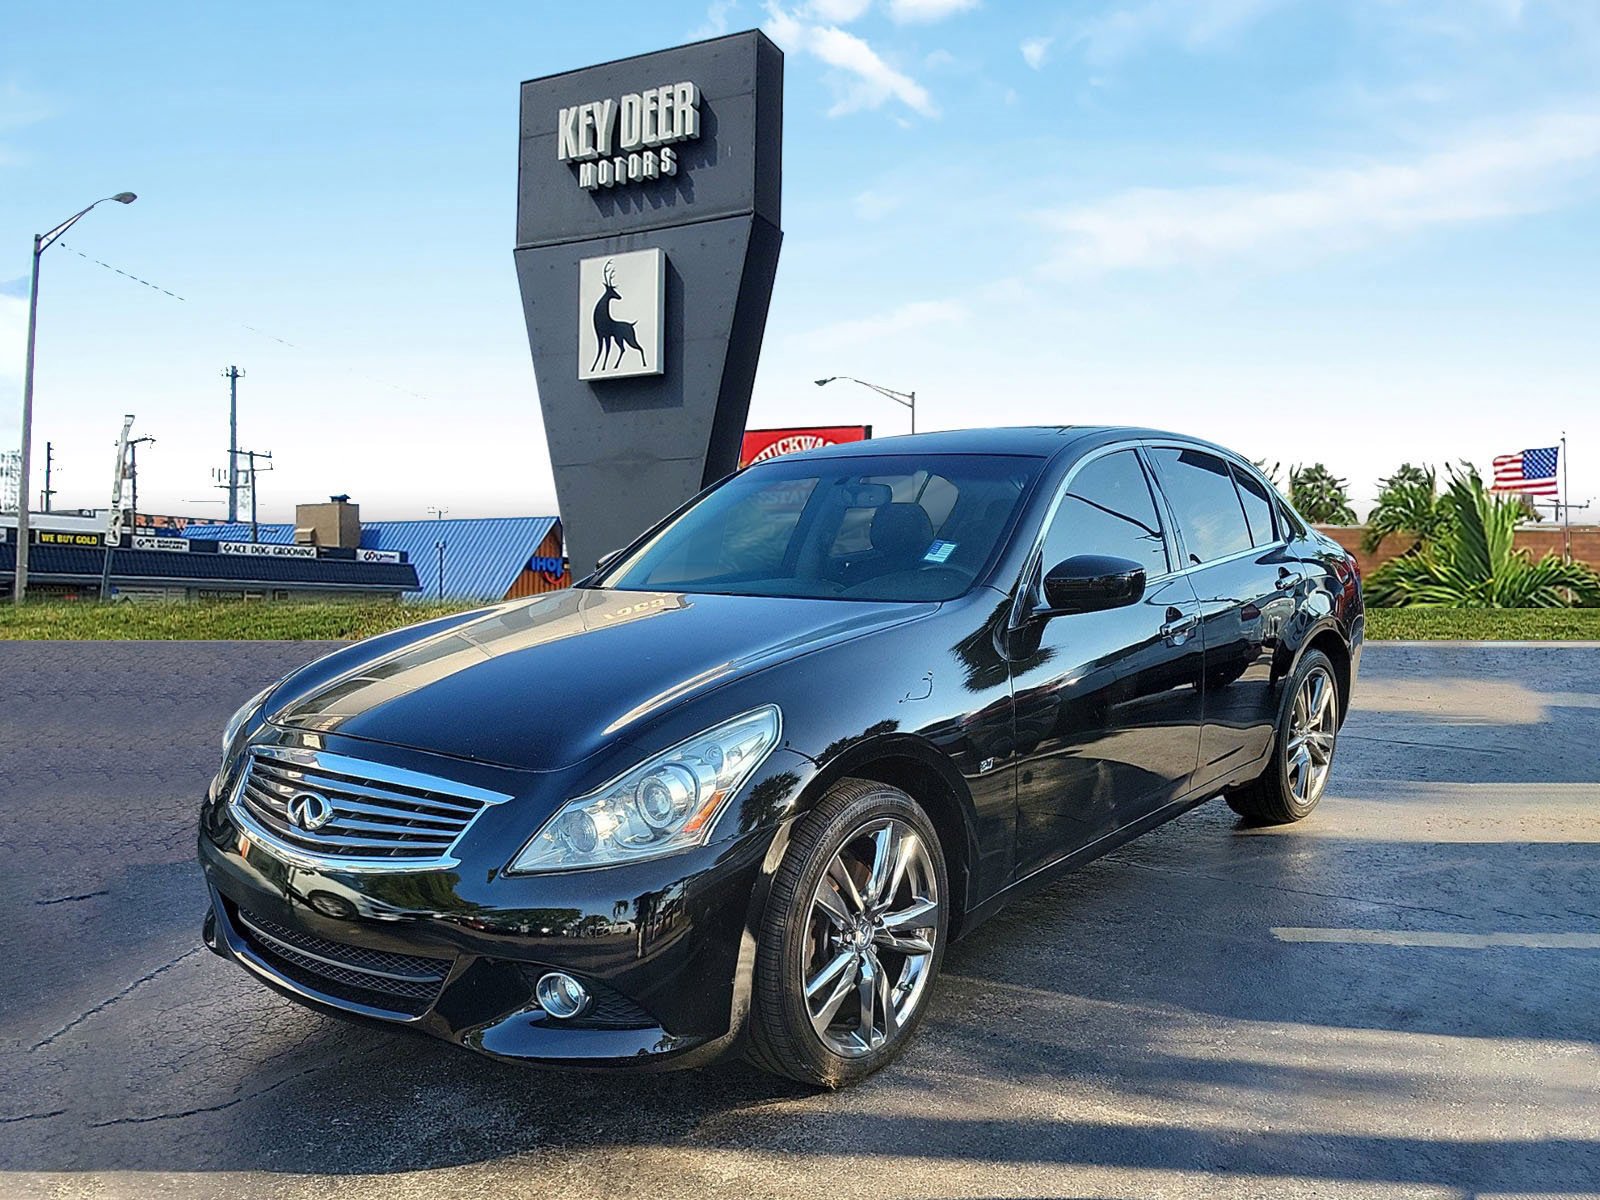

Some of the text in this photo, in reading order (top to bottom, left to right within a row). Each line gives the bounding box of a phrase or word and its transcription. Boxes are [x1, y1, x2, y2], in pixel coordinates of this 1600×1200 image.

[558, 81, 700, 160] KEY DEER
[579, 147, 677, 190] MOTORS
[41, 533, 97, 545] WE BUY GOLD
[233, 545, 314, 557] ACE DOG GROOMING
